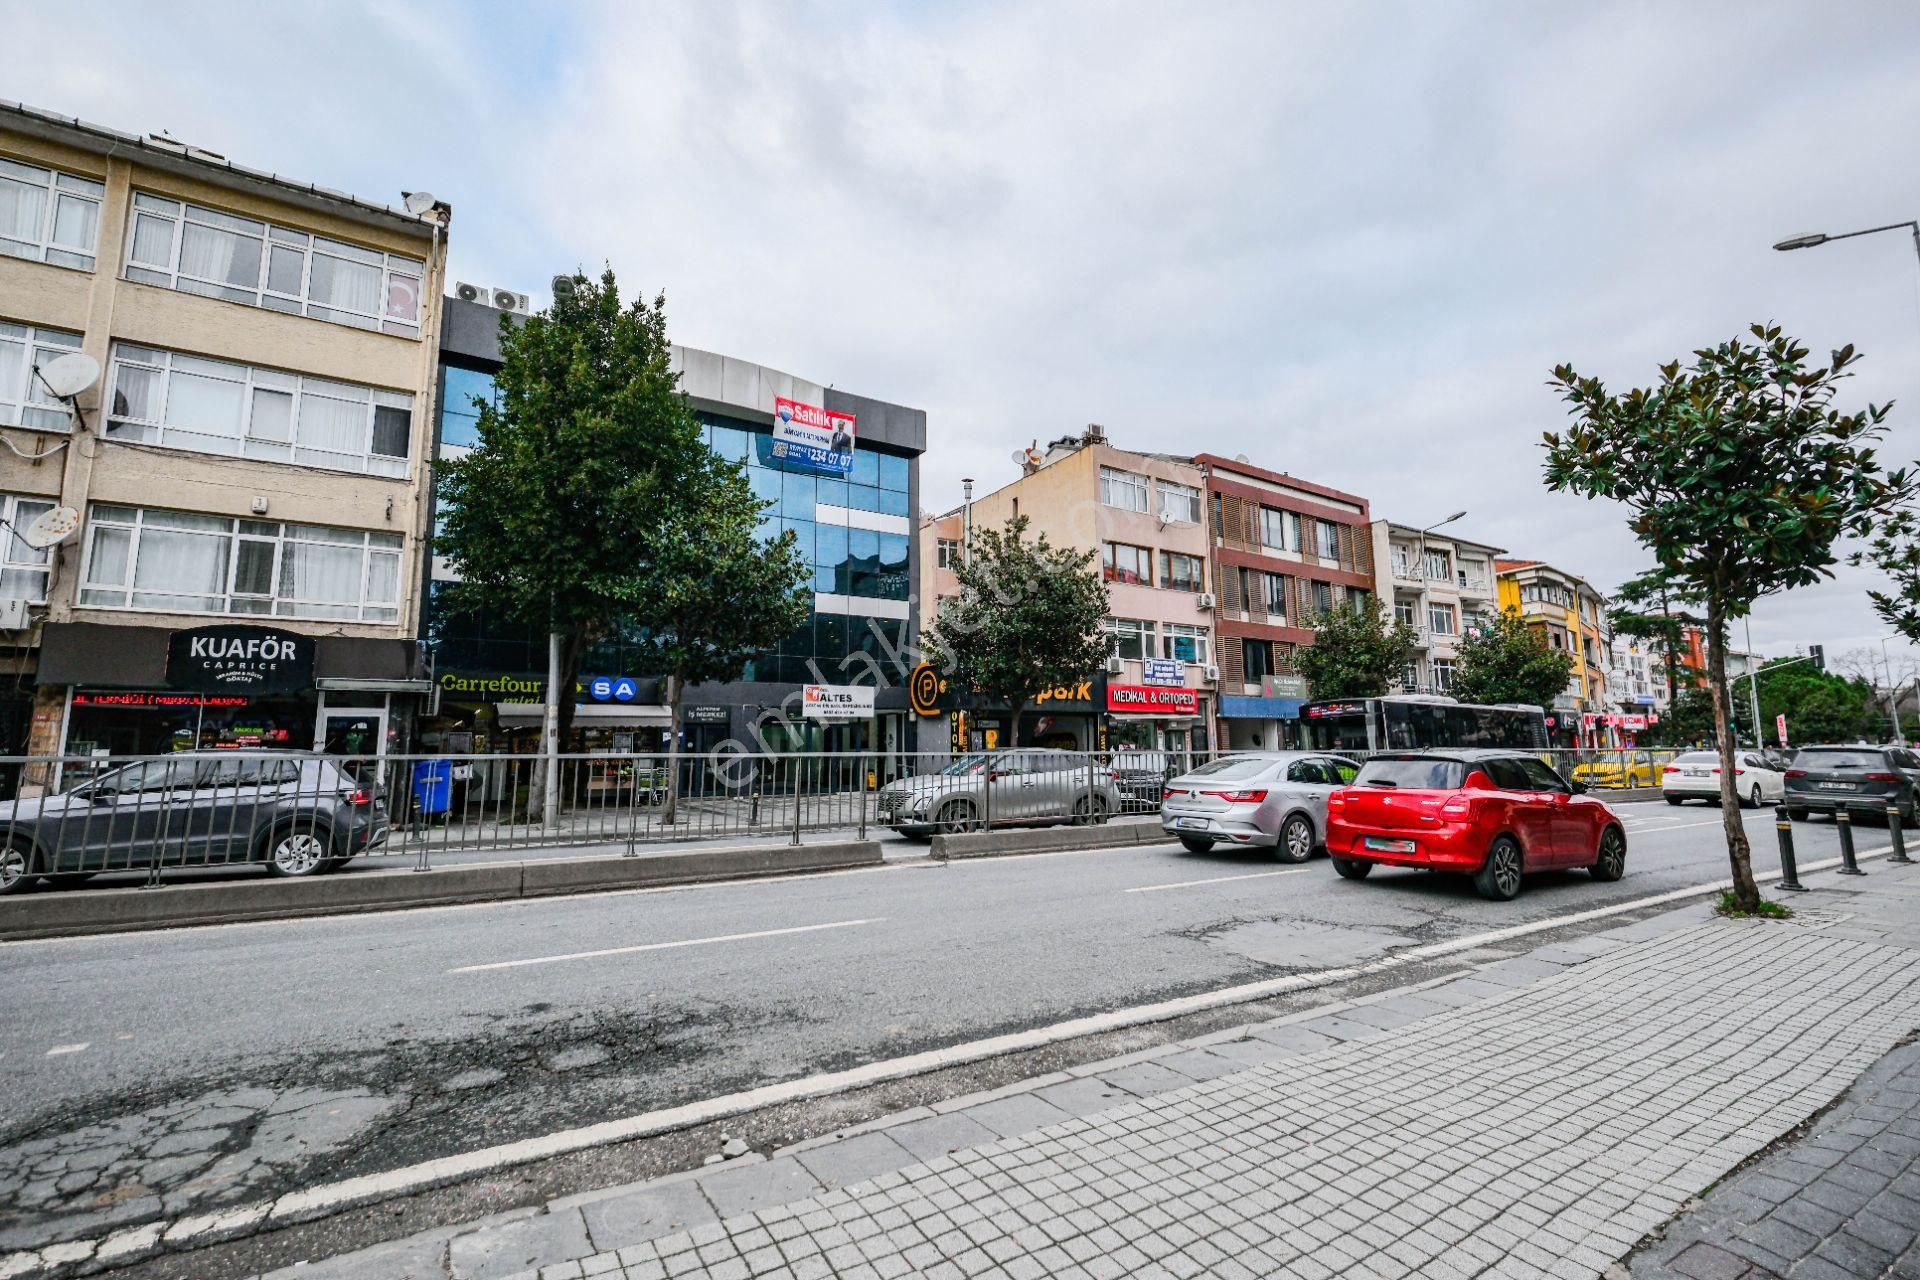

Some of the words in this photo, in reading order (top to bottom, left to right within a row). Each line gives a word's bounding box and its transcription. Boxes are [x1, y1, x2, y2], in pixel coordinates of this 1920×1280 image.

[794, 404, 832, 428] Satılık
[190, 635, 297, 661] KUAFÖR
[203, 661, 277, 670] CAPRICE
[441, 674, 542, 693] Carrefour
[503, 694, 541, 705] mini
[820, 694, 853, 703] ALTES
[1113, 688, 1147, 703] MEDİKAL
[1150, 691, 1157, 703] &
[1158, 691, 1195, 705] ORTOPEDİ
